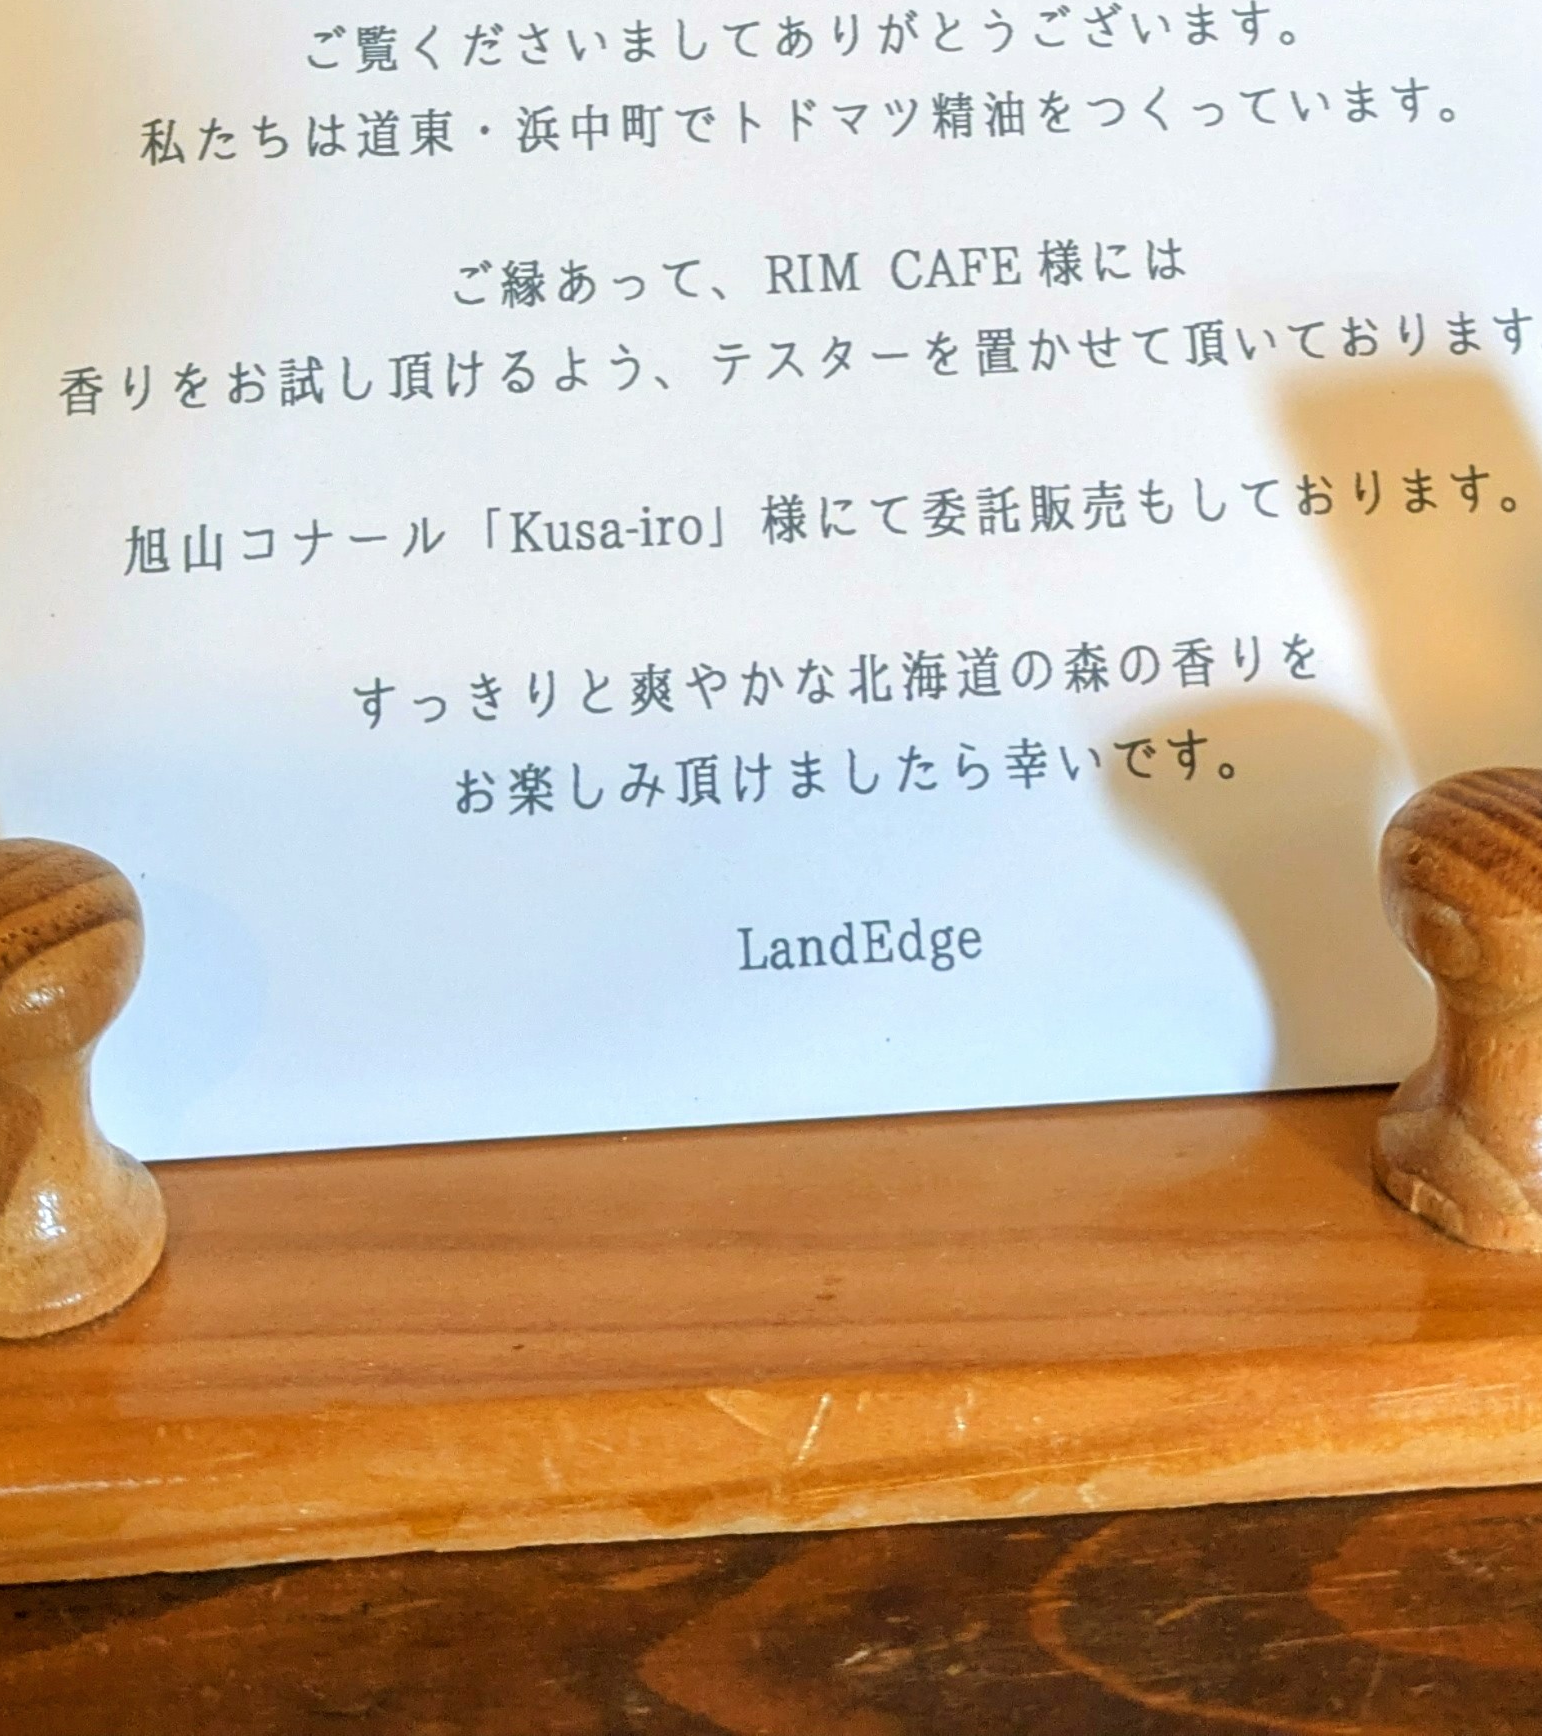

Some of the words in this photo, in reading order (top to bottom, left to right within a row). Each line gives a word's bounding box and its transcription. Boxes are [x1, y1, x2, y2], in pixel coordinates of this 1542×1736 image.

[139, 75, 1457, 167] 私たちは道東・浜中町でトドマツ精油をつくっています。
[351, 631, 1317, 731] すっきりと爽やかな北海道の森の香りを
[454, 727, 1237, 818] お楽しみ頂けましたら幸いです。
[735, 916, 984, 973] LandEdge
